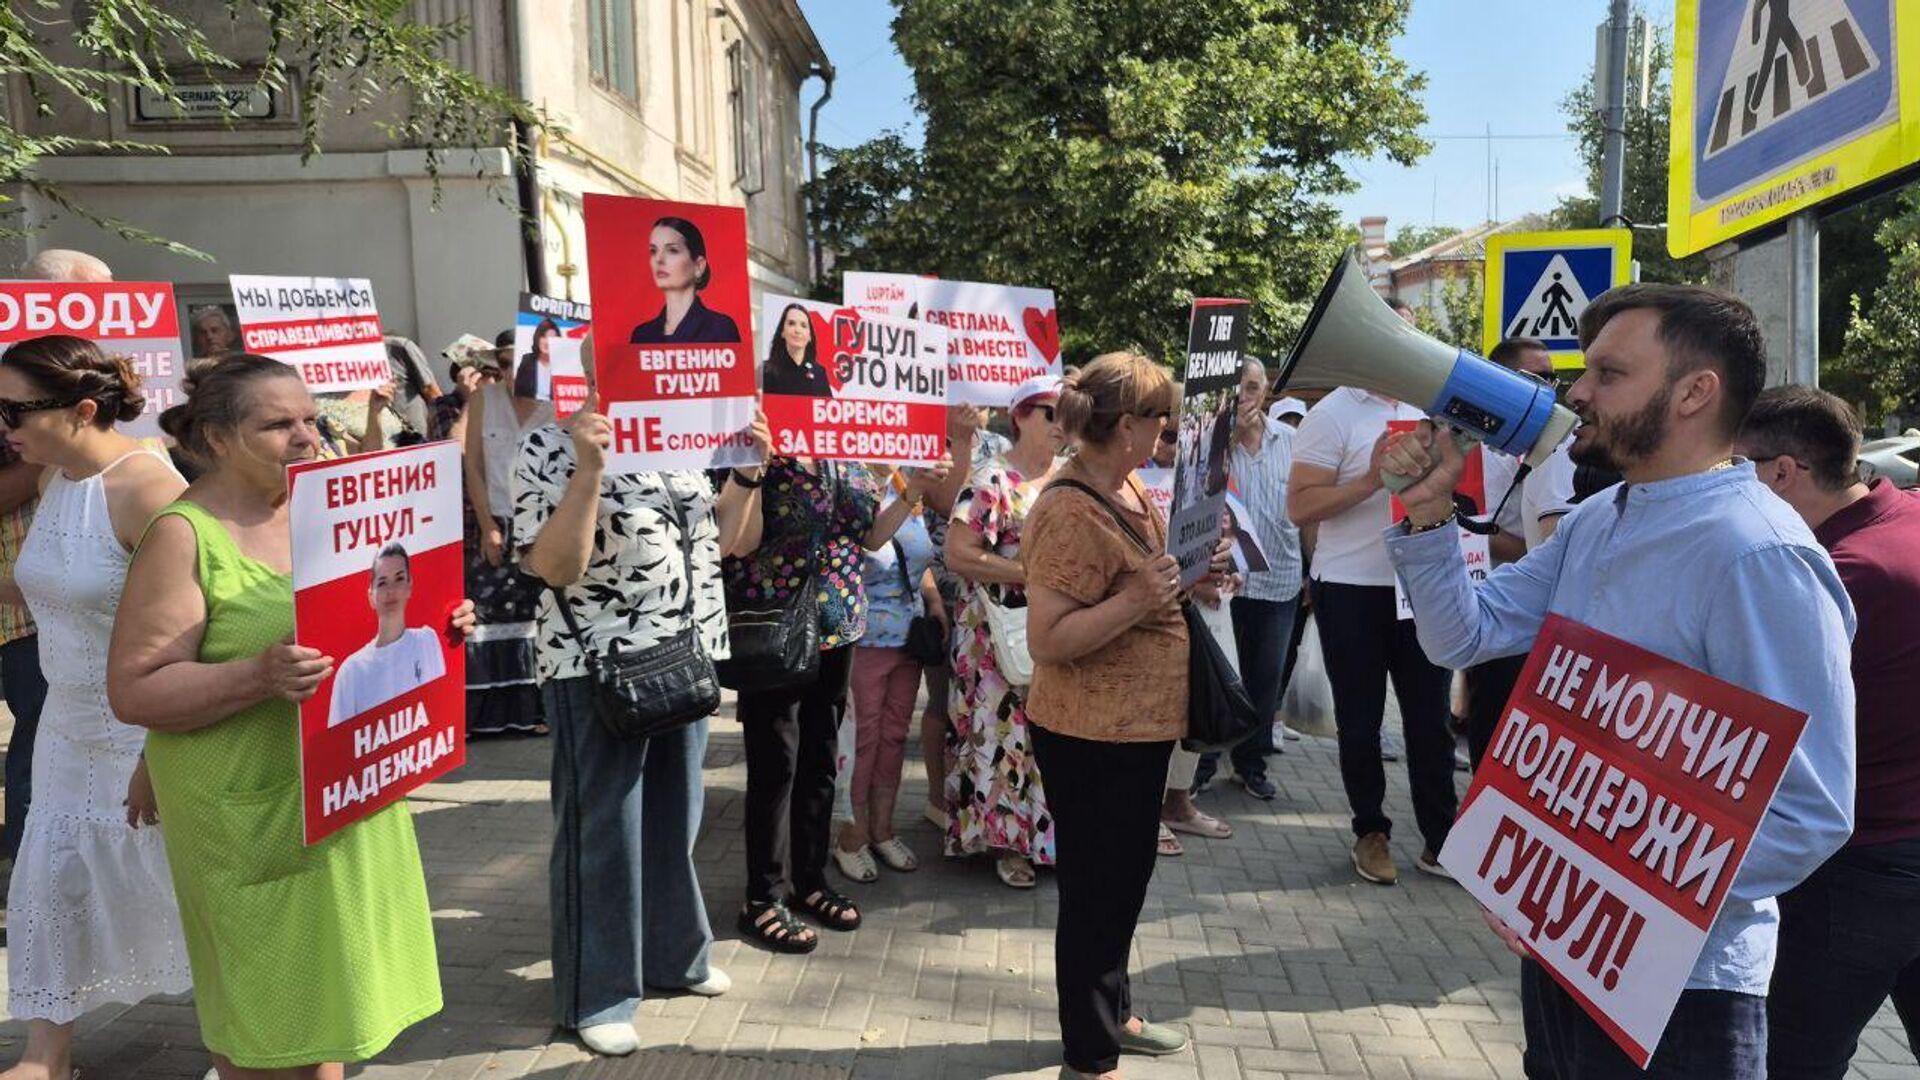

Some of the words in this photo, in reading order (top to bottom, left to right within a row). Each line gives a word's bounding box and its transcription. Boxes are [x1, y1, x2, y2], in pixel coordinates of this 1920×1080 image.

[237, 288, 272, 308] МЫ
[279, 288, 371, 312] ДОБЬЕМСЯ
[246, 320, 381, 349] СПРАВЕДЛИВОСТИ
[926, 310, 1014, 334] СВЕТЛАНА,
[1214, 315, 1234, 342] ЛЕТ
[834, 317, 916, 358] ГУЦУЛ
[963, 338, 1028, 358] ВМЕСТЕ!
[302, 359, 390, 385] ЕВГЕНИИ!
[639, 348, 737, 372] ЕВГЕНИЮ
[1188, 352, 1207, 379] БЕЗ
[1206, 350, 1238, 377] МАМЫ
[654, 372, 721, 397] ГУЦУЛ
[834, 353, 887, 388] ЭТО
[895, 362, 944, 398] МЫ!
[966, 364, 1047, 386] ПОБЕДИМ!
[812, 399, 908, 426] БОРЕМСЯ
[613, 416, 664, 454] НЕ
[779, 430, 810, 454] ЗА
[813, 430, 838, 455] ЕЕ
[842, 431, 939, 460] СВОБОДУ!
[326, 460, 436, 510] ЕВГЕНИЯ
[332, 506, 414, 554] ГУЦУЛ
[353, 701, 429, 759] НАША
[1535, 644, 1593, 712] НЕ
[1581, 662, 1770, 801] МОЛЧИ!
[322, 725, 456, 817] НАДЕЖДА!
[1491, 707, 1735, 908] ПОДДЕРЖИ
[1476, 814, 1647, 992] ГУЦУЛ!
